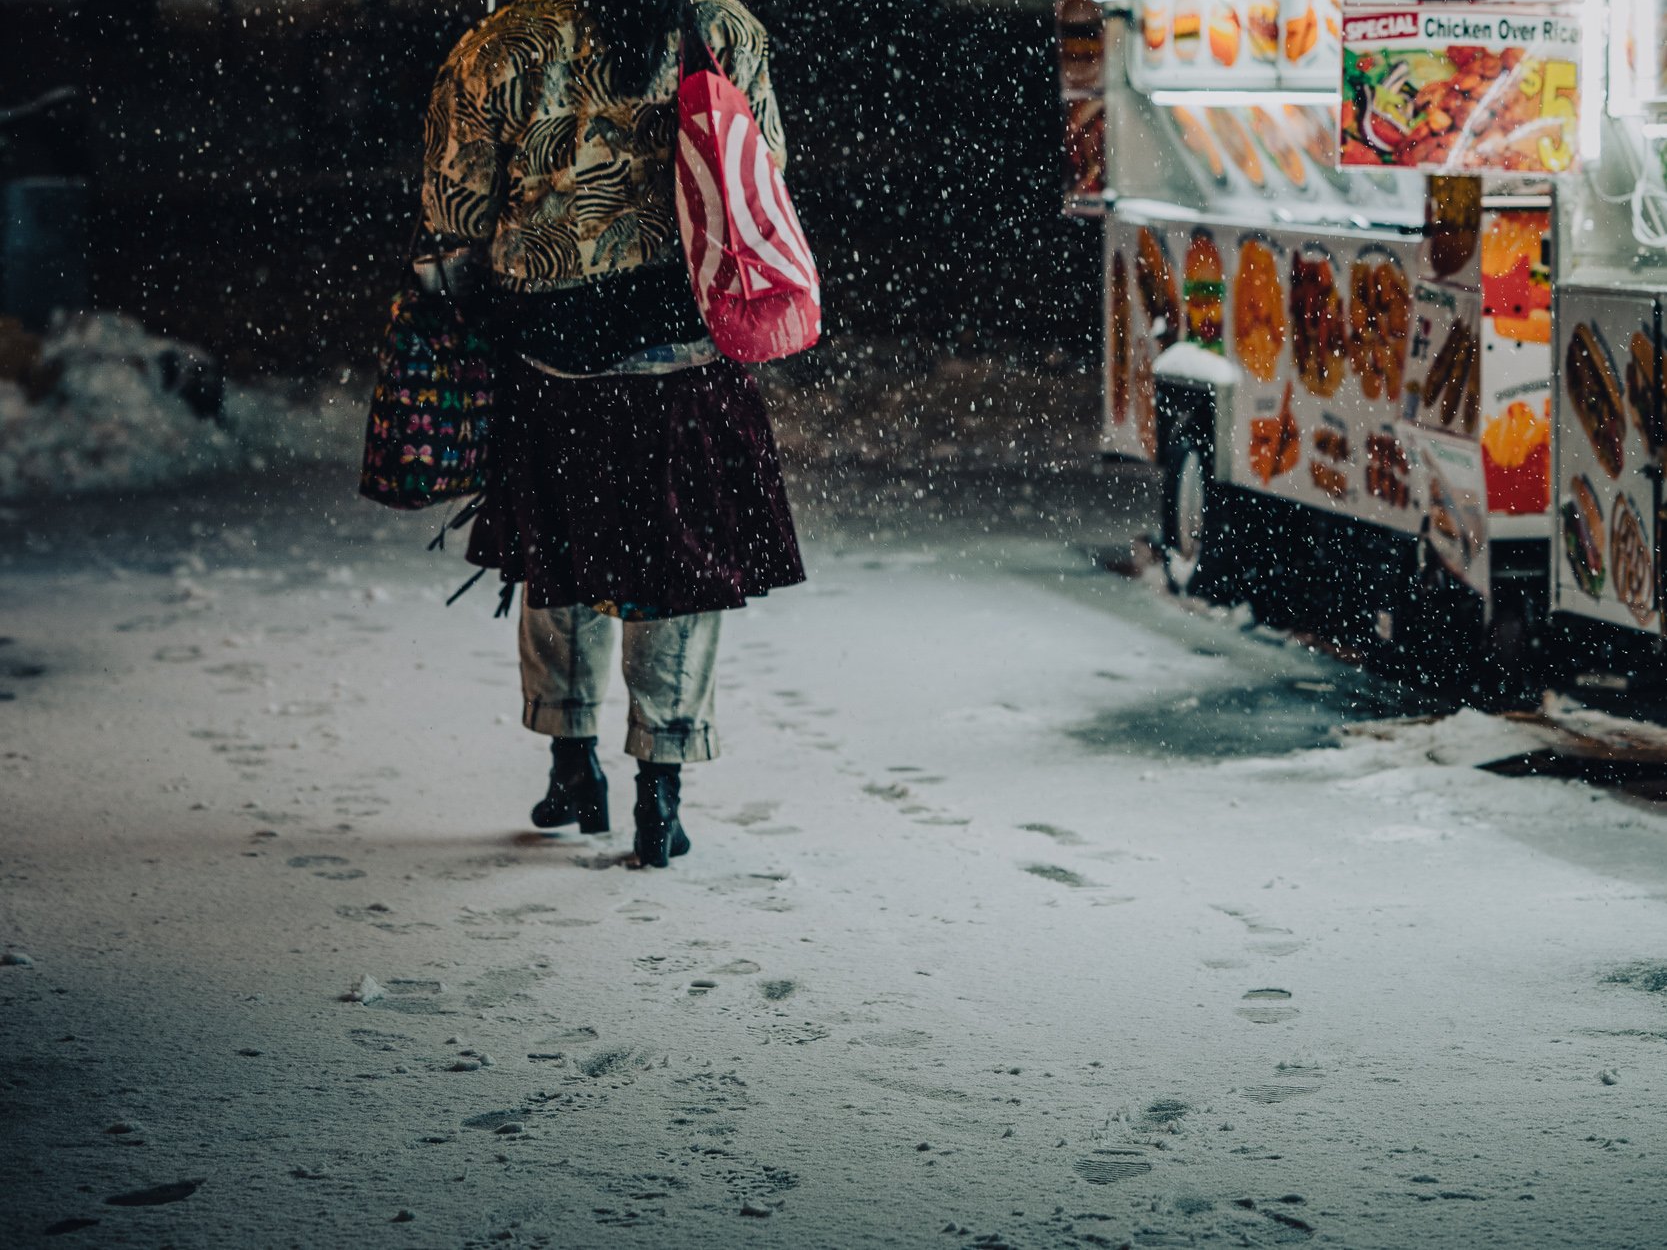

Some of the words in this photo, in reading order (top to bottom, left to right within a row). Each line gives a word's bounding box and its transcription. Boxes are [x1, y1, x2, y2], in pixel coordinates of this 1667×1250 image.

[1345, 15, 1418, 41] SPECIAL
[1424, 18, 1492, 40] Chicken
[1499, 19, 1537, 41] Over
[1543, 20, 1581, 43] Rice
